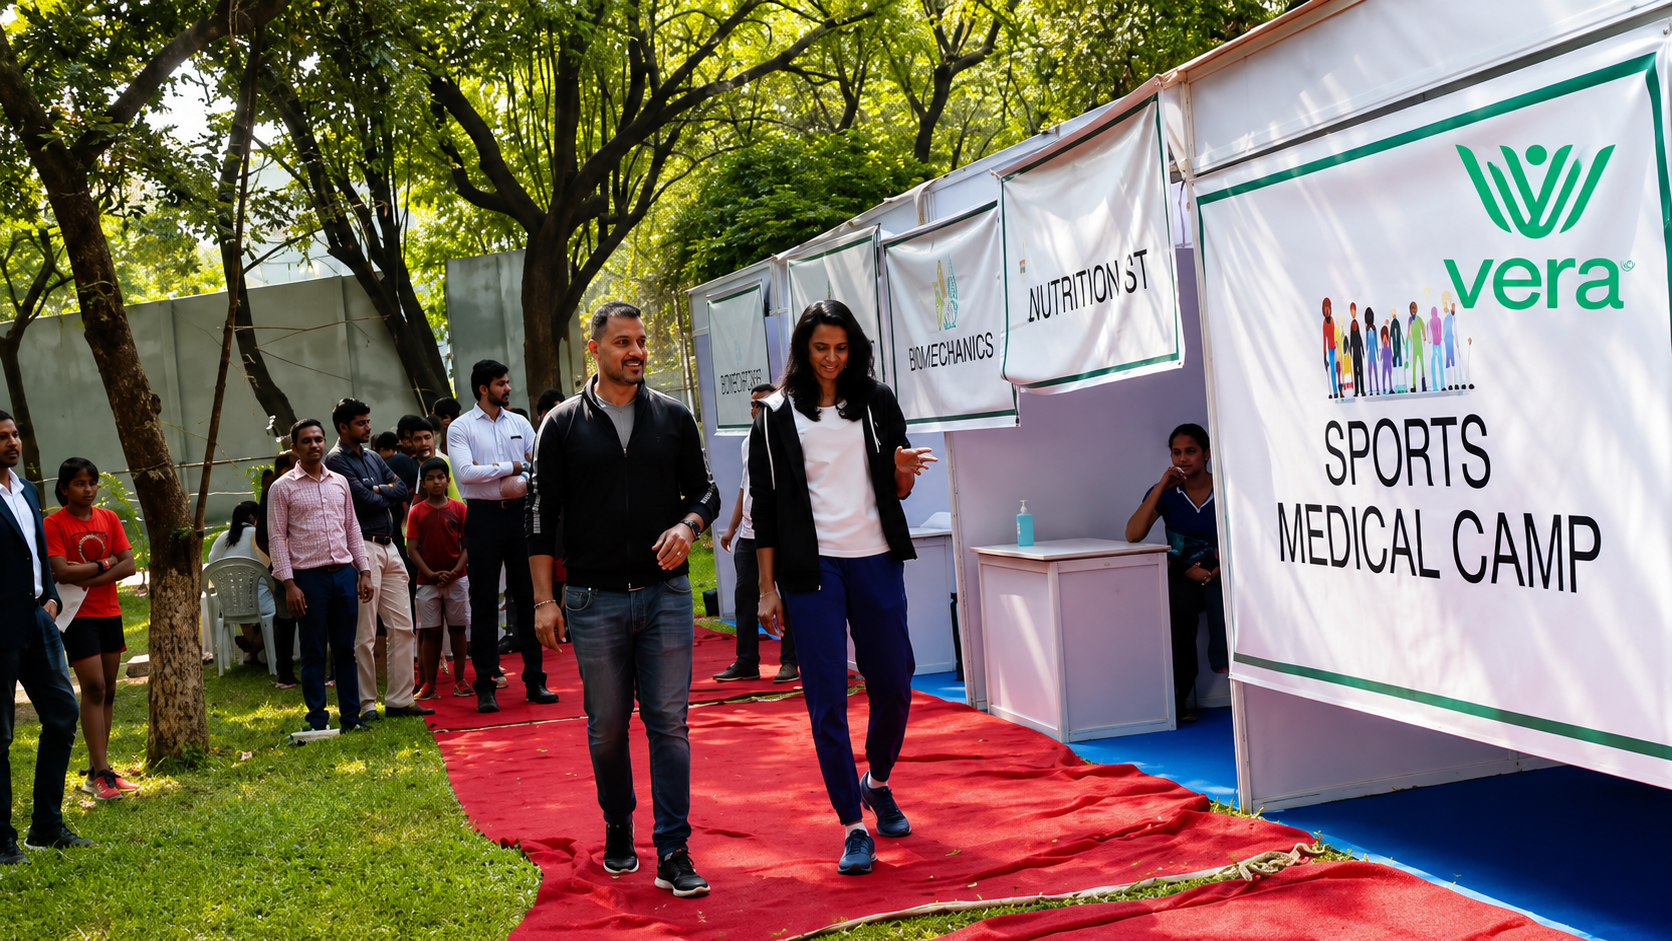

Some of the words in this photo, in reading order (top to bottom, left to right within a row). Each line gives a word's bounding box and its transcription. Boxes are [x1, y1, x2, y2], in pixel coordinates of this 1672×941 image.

[1028, 248, 1148, 322] NUTRITIONST
[1443, 257, 1624, 310] vera
[1325, 413, 1491, 489] SPORTS
[1277, 502, 1441, 579] MEDICAL
[1452, 509, 1602, 593] CAMP
